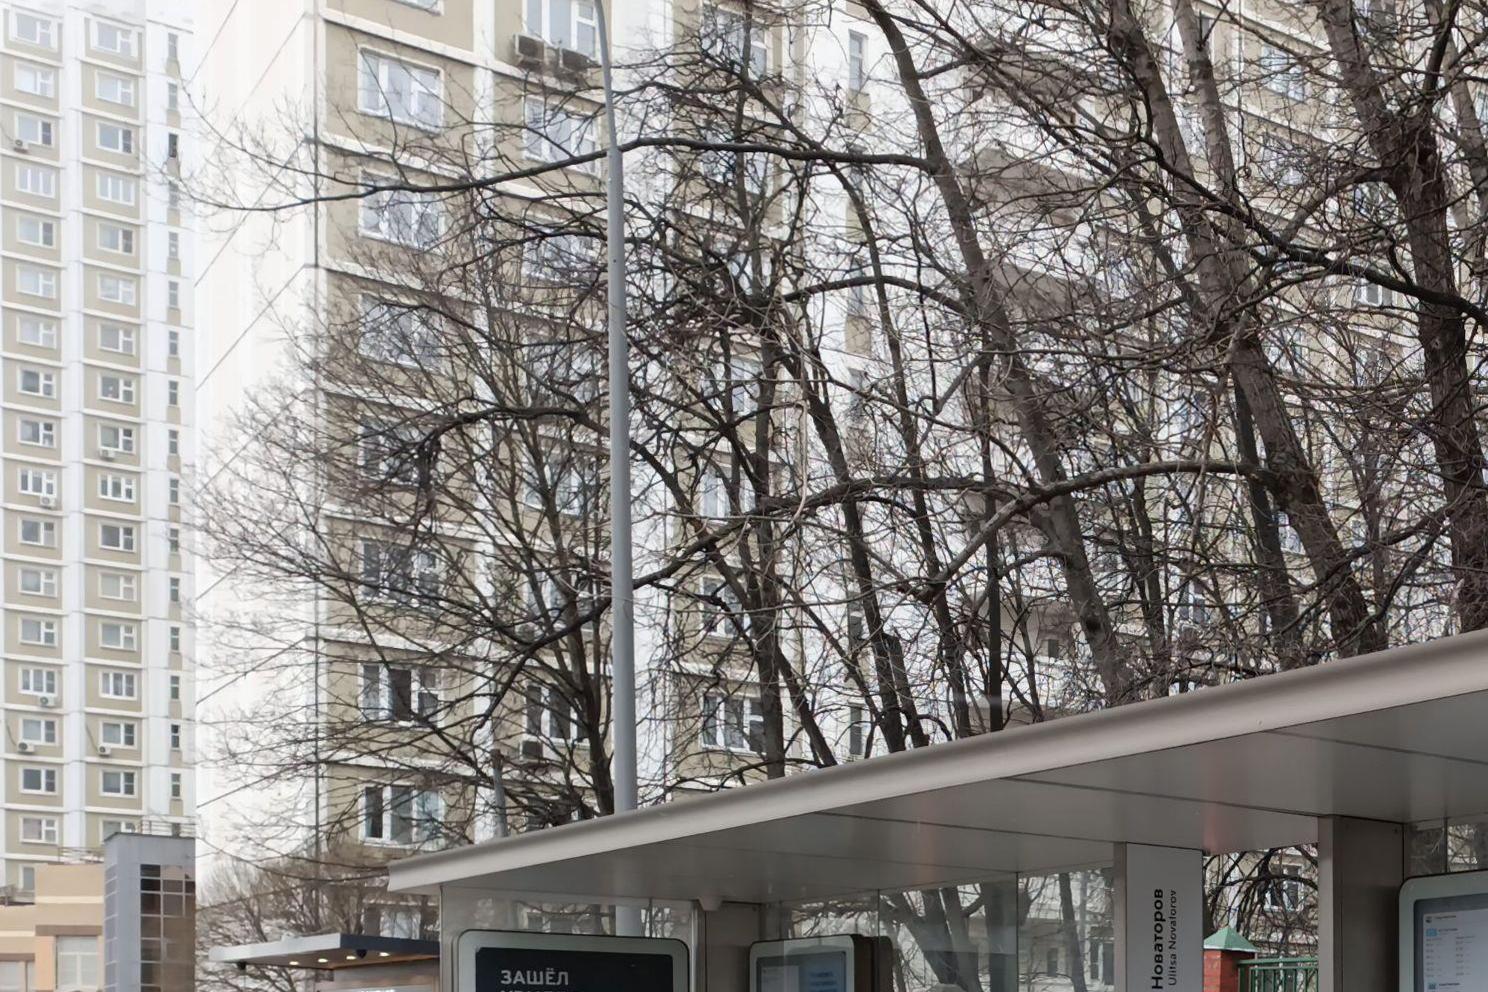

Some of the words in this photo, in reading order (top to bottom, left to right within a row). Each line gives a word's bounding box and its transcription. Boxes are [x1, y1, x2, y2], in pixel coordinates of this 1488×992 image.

[1151, 888, 1166, 989] Новаторов
[1168, 890, 1177, 950] Novatorov
[501, 968, 569, 985] ЗАШЁЛ
[1168, 954, 1177, 986] Ulitsa
